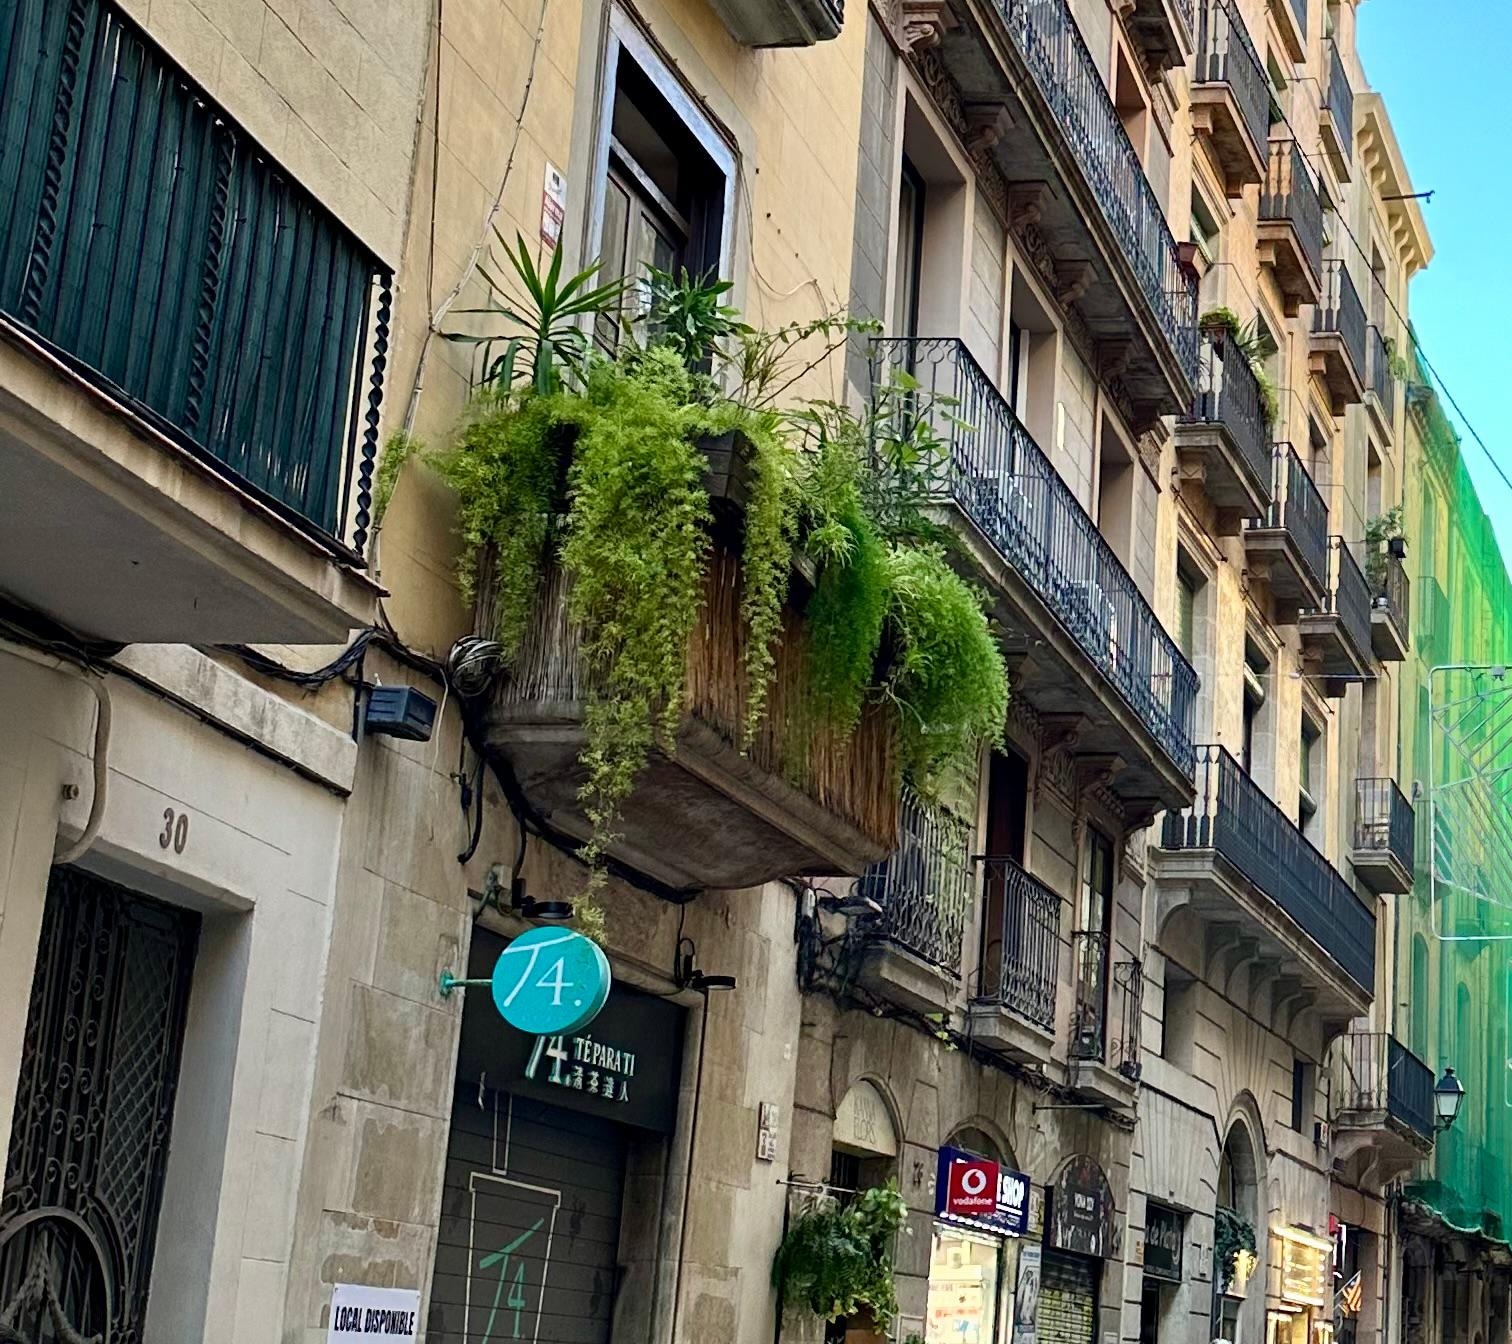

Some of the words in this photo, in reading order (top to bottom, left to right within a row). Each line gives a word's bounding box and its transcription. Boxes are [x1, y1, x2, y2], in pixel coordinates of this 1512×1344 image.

[159, 807, 188, 855] 30
[573, 1034, 593, 1063] TÉ
[592, 1039, 622, 1071] PARA
[623, 1052, 636, 1077] TI
[952, 1196, 993, 1206] vodafone
[1001, 1175, 1025, 1208] SHOP
[334, 1306, 362, 1333] LOCAL
[364, 1307, 415, 1336] DISPONIBLE
